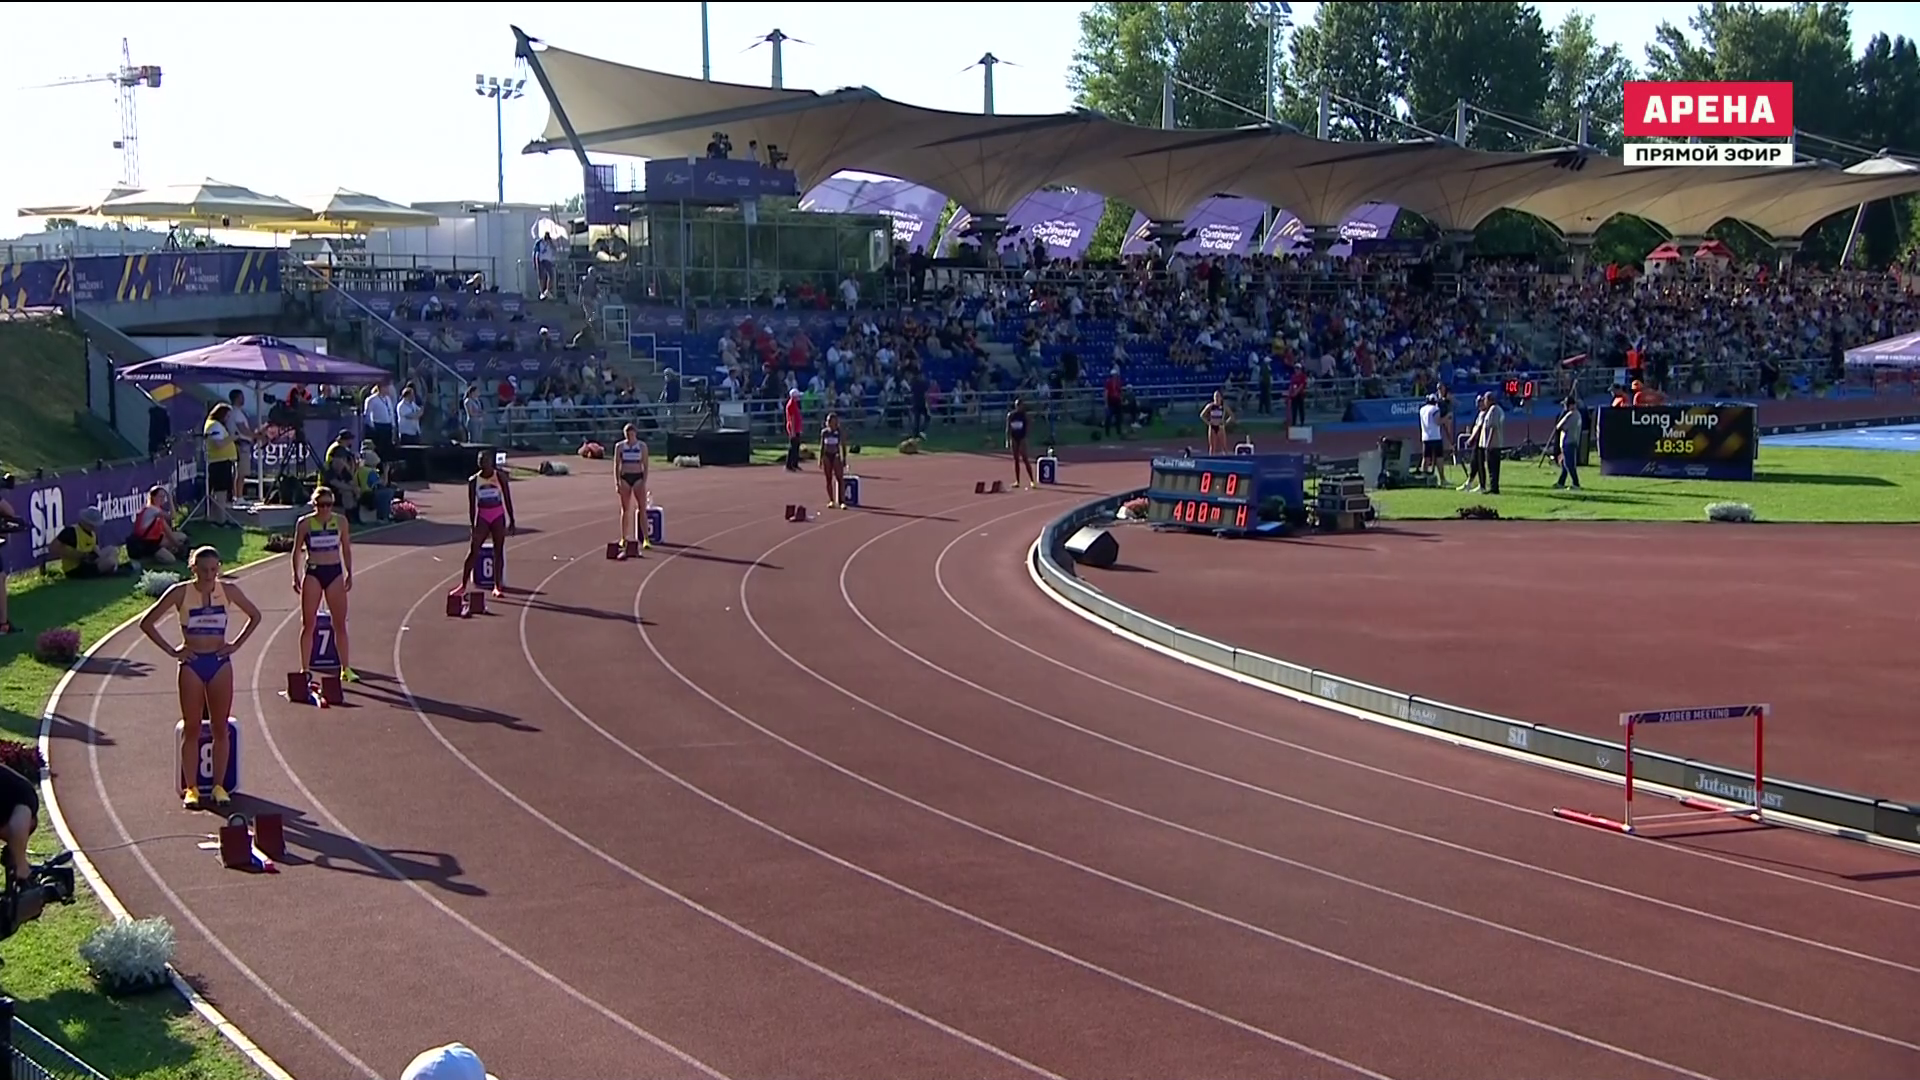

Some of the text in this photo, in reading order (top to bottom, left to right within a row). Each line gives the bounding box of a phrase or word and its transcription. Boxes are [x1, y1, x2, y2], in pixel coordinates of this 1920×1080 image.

[1048, 234, 1072, 248] Gold
[1200, 227, 1243, 241] Continental
[1214, 240, 1234, 251] Gold
[1631, 410, 1719, 430] Long Jump
[1662, 428, 1686, 439] Men
[1654, 440, 1694, 453] 18:35
[1043, 465, 1050, 479] 3
[30, 486, 65, 549] sn
[1172, 500, 1248, 528] 400m H
[646, 518, 653, 537] 5
[482, 557, 493, 578] 6
[318, 629, 331, 656] 7
[1659, 708, 1729, 723] ZAGREB MEETING
[200, 742, 214, 779] 8
